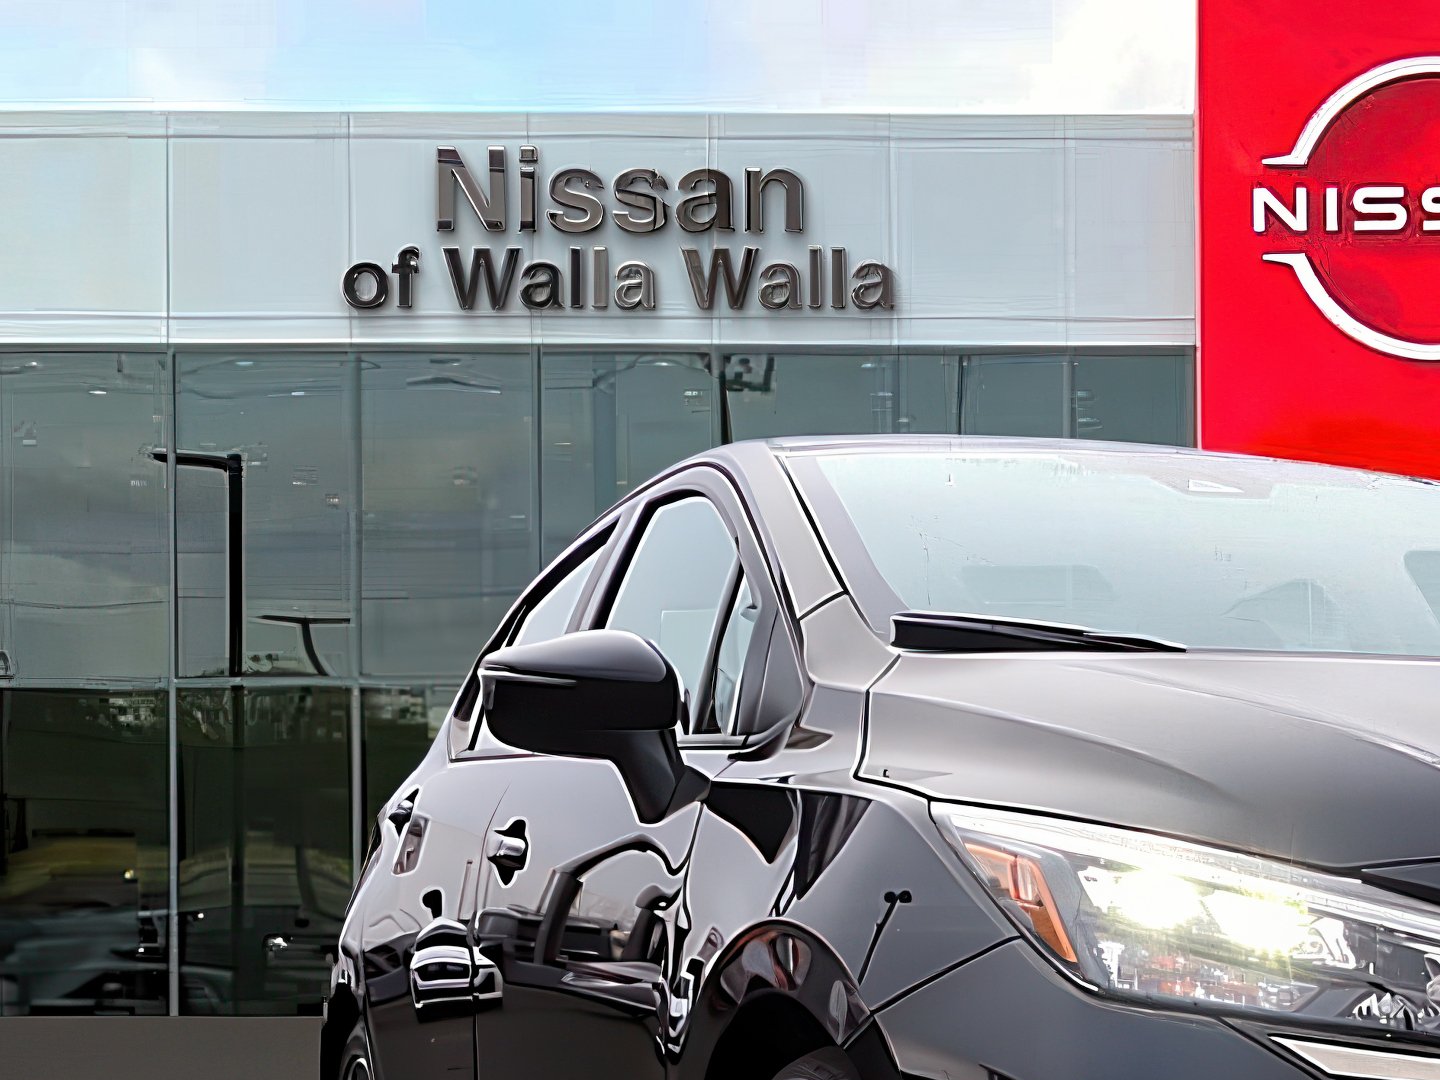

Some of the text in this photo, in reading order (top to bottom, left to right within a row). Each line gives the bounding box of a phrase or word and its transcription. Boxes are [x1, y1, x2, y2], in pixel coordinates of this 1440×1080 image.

[435, 145, 808, 233] Nissan
[341, 244, 895, 311] of Walla Walla
